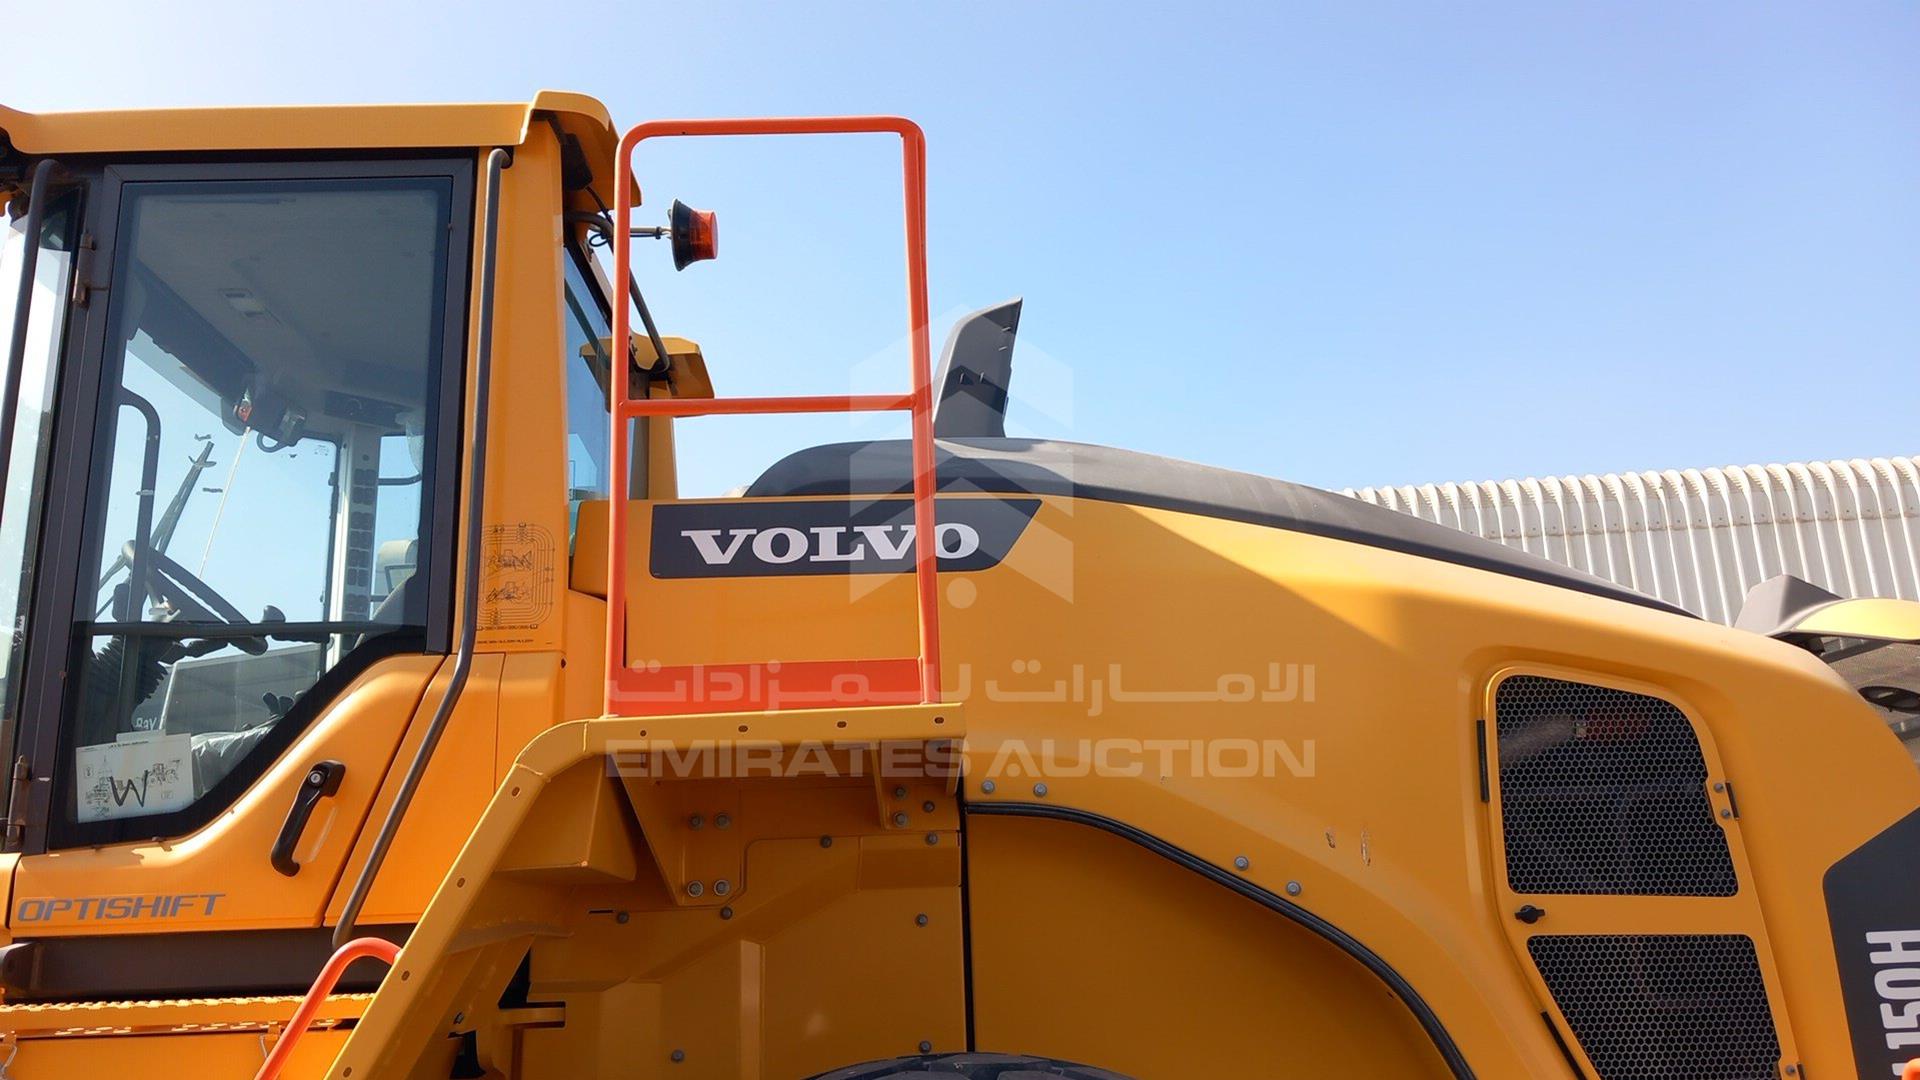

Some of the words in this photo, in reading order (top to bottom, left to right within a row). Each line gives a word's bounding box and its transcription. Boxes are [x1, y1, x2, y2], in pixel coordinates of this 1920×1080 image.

[680, 522, 981, 565] VOLVO
[17, 893, 227, 922] OPTISHIFT
[1865, 929, 1920, 1077] 150H
